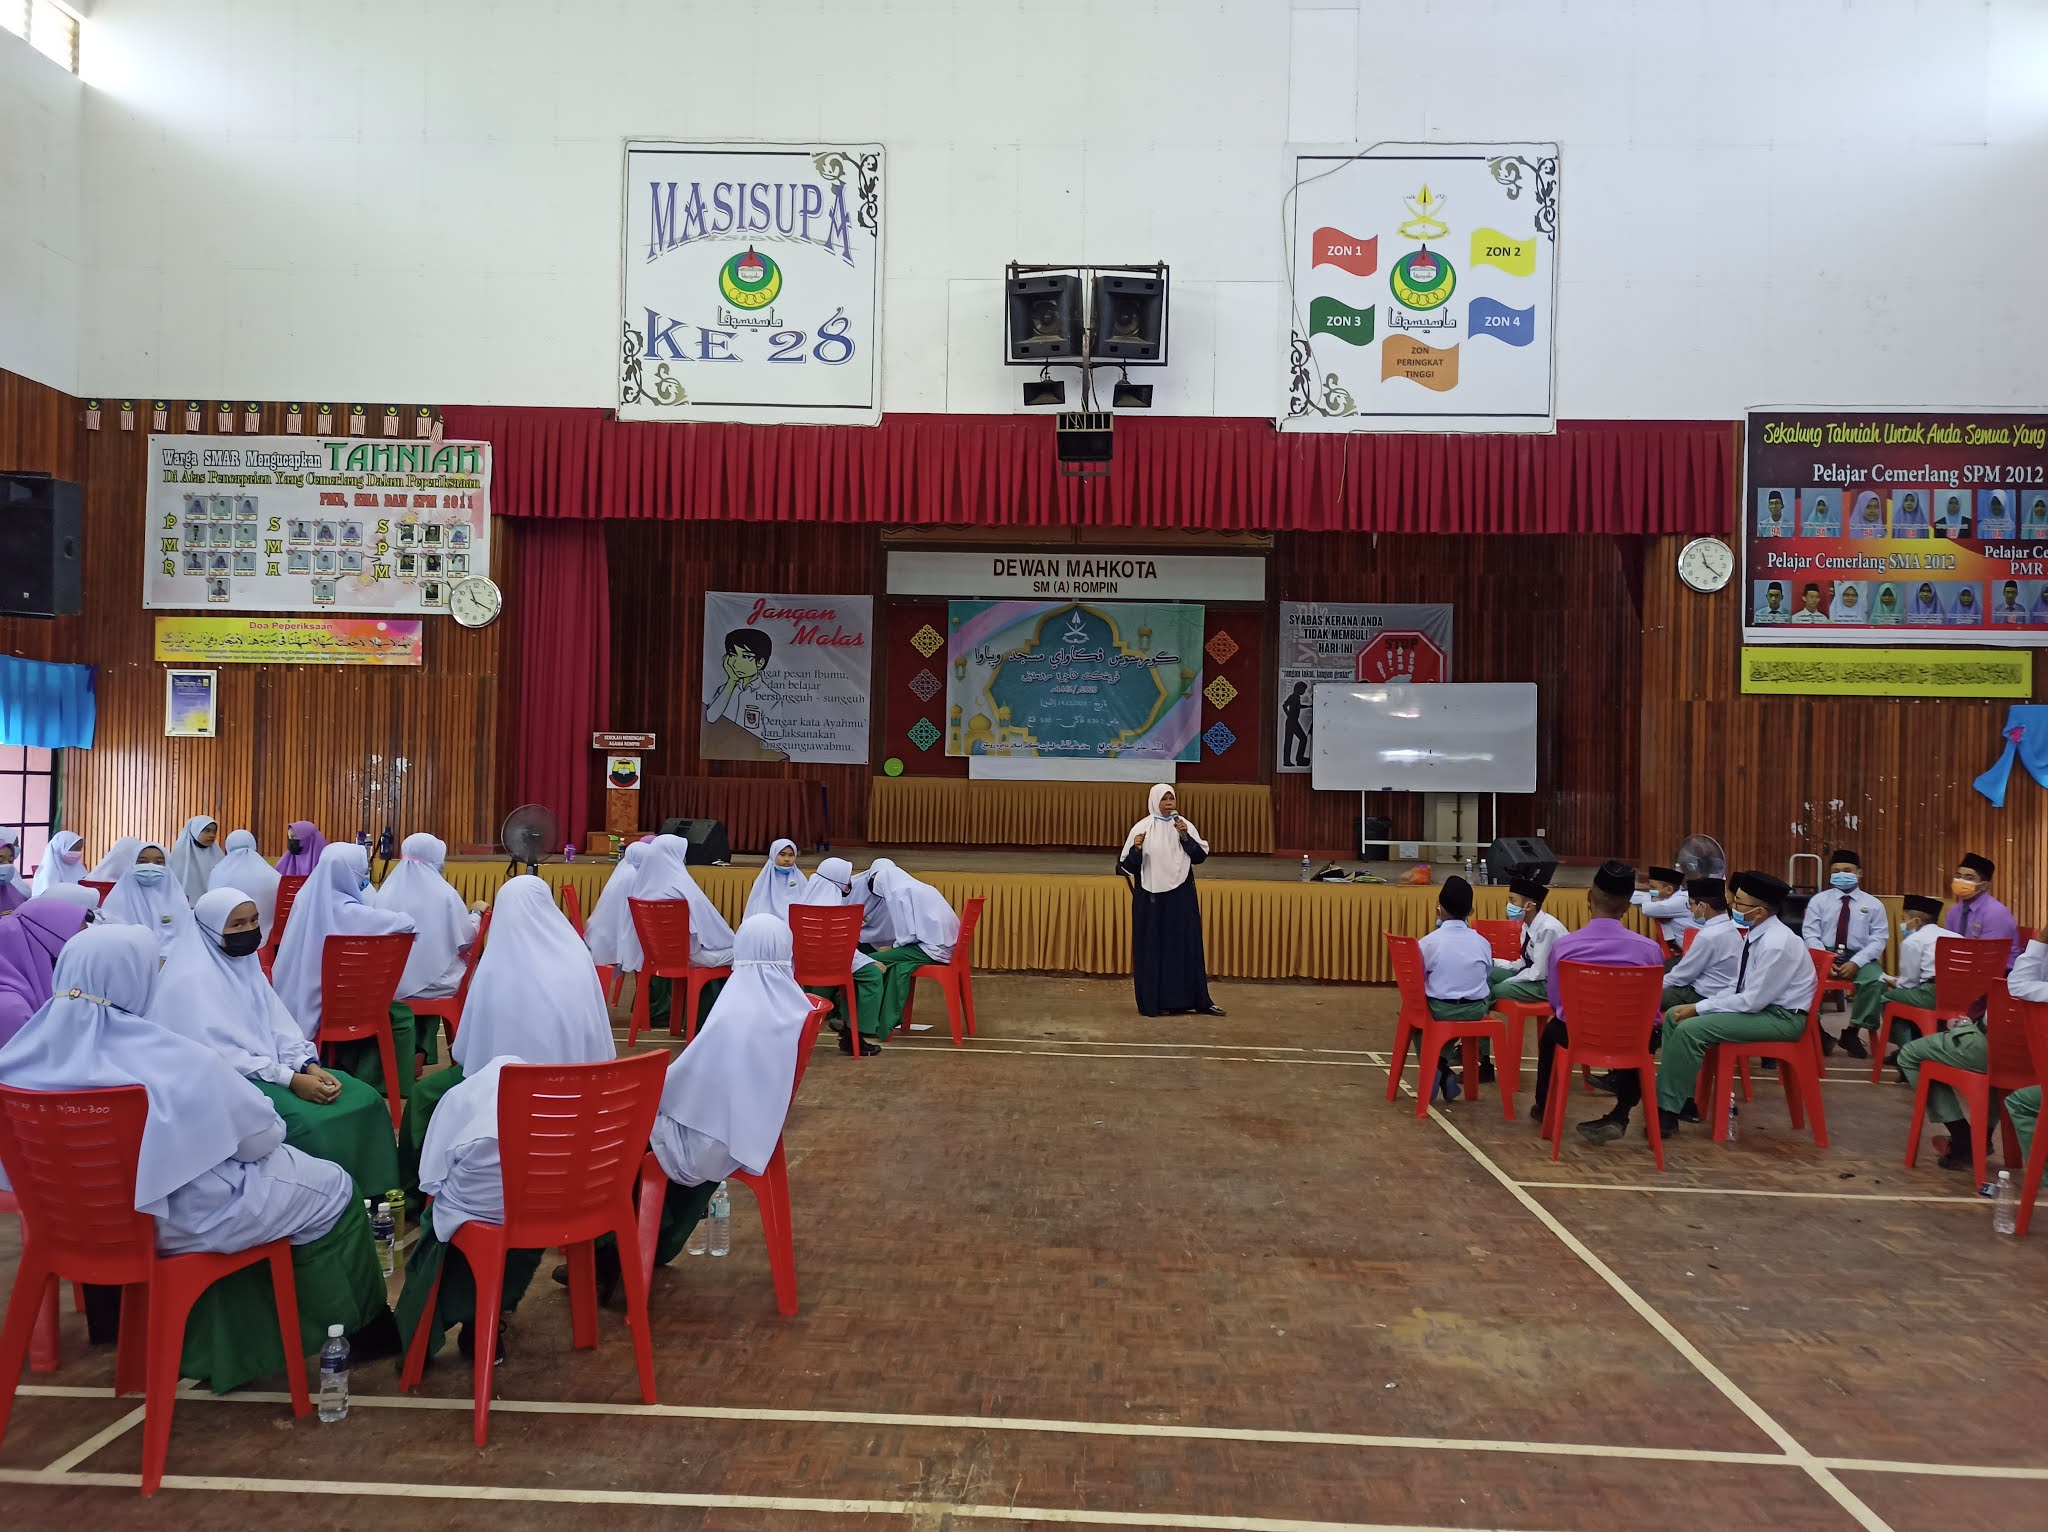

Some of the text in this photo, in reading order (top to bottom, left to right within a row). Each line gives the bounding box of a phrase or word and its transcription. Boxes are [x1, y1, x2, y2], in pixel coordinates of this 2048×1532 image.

[647, 182, 855, 267] MASISUPA
[1327, 245, 1362, 256] ZON 1
[1486, 246, 1521, 257] ZON 2
[1326, 316, 1361, 327] ZON 3
[1484, 316, 1521, 327] ZON 4
[643, 306, 855, 364] KE 28
[1411, 346, 1429, 354] ZON
[1396, 357, 1444, 367] PERINGKAT
[1405, 369, 1434, 378] TINGGI
[1764, 421, 2046, 449] Sekalung Tahniah Untuk Anda Semua Yang
[163, 443, 482, 474] Warga SMAR Mengucapkan TAHNIAH
[164, 470, 177, 483] Di
[180, 471, 205, 484] Atas
[208, 472, 271, 487] Pencapaian
[275, 472, 304, 487] Yang
[305, 473, 364, 489] Cemerlang
[366, 474, 403, 487] Dalam
[1813, 463, 2043, 488] Pelajar Cemerlang SPM 2012
[354, 493, 379, 506] SMA
[384, 494, 408, 507] DAN
[413, 495, 438, 508] SPM
[443, 495, 474, 508] 2011
[1984, 545, 2029, 562] Pelajar
[993, 558, 1157, 579] DEWAN MAHKOTA
[1767, 552, 1955, 574] Pelajar Cemerlang SMA 2012
[2010, 562, 2041, 575] PMR
[1033, 581, 1118, 594] SM (A) ROMPIN
[747, 598, 836, 626] Jangan
[249, 621, 333, 632] Doa Peperiksaan
[1289, 614, 1384, 627] SYABAS KERANA ANDA
[789, 625, 865, 647] Malas
[1303, 628, 1368, 641] TIDAK MEMBULI
[1318, 642, 1353, 654] HARI INI
[1385, 638, 1418, 650] STOP
[783, 671, 811, 681] pesan
[768, 681, 821, 693] dan belajar
[755, 692, 813, 704] bersungguh
[823, 695, 865, 706] sungguh
[761, 715, 797, 729] Dengar
[800, 718, 820, 727] kata
[761, 727, 779, 738] dan
